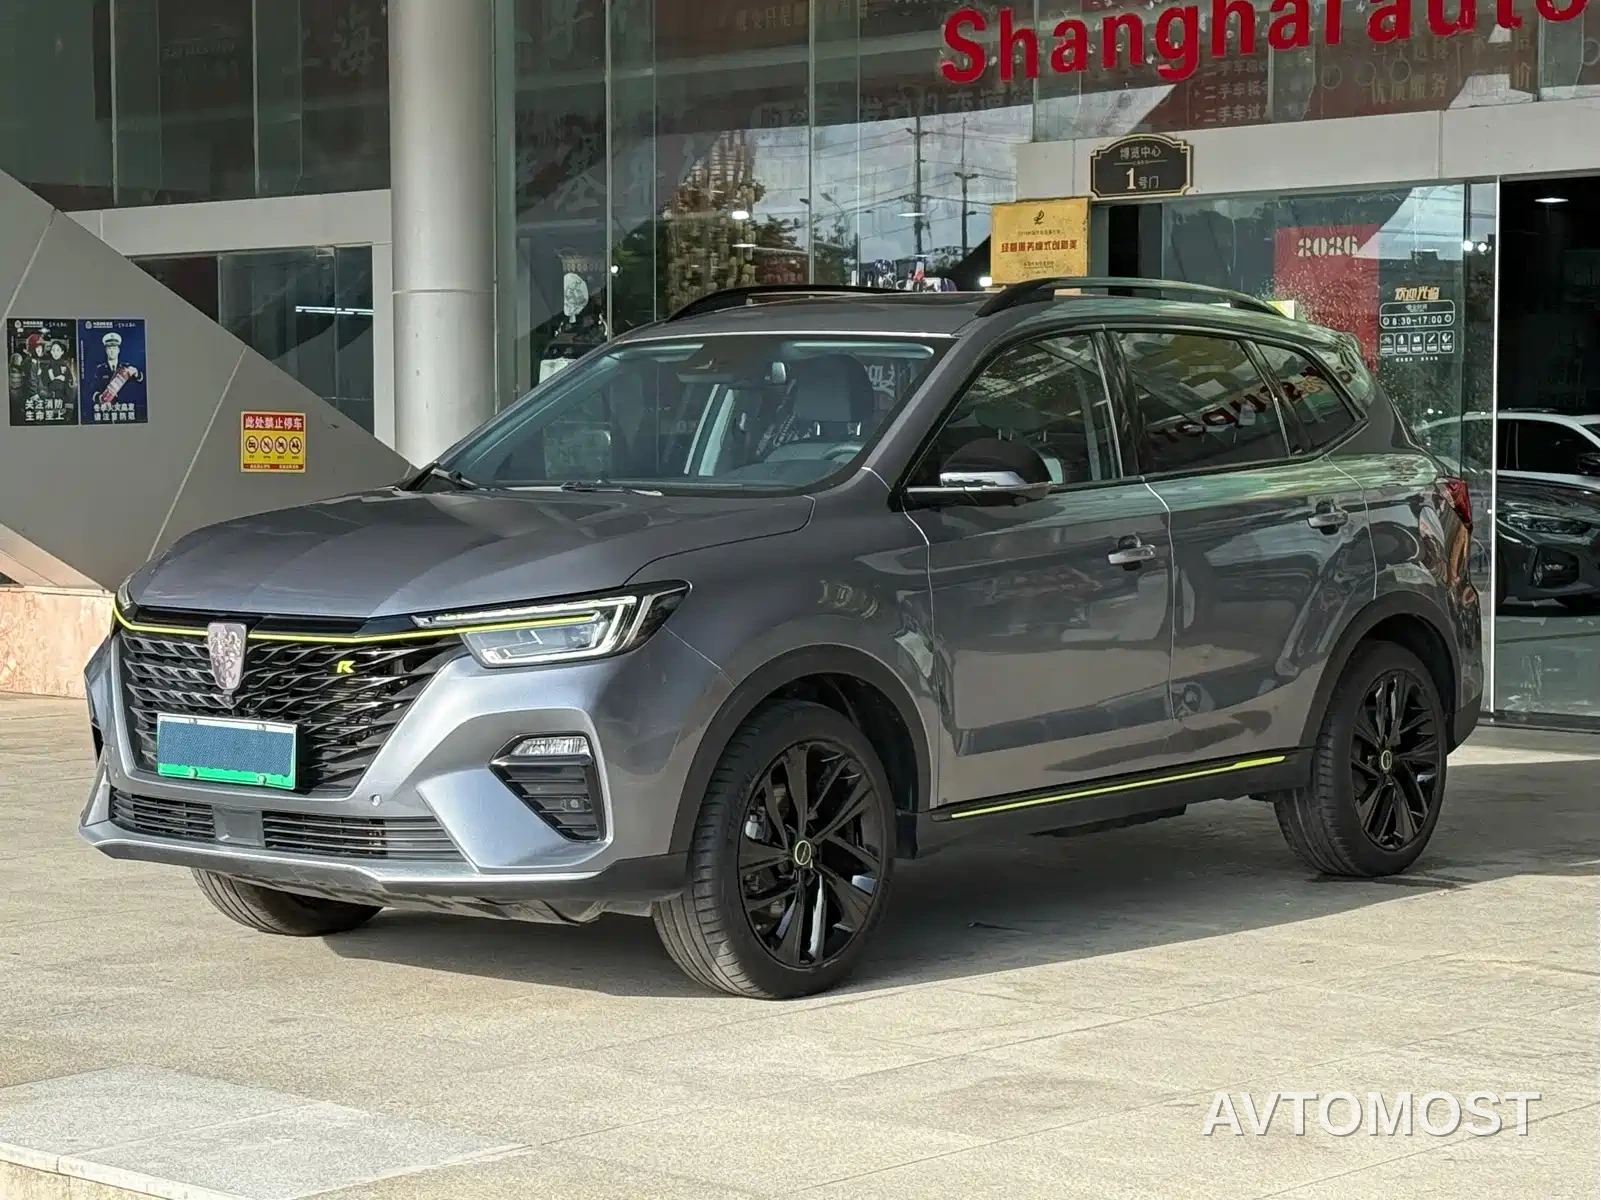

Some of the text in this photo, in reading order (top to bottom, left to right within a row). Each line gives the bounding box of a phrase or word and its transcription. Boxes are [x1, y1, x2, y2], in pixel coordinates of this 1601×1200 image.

[1120, 145, 1161, 160] 博览中心
[25, 399, 64, 410] 关注消防
[25, 410, 64, 421] 生命至上
[244, 415, 303, 431] 此处禁止停车
